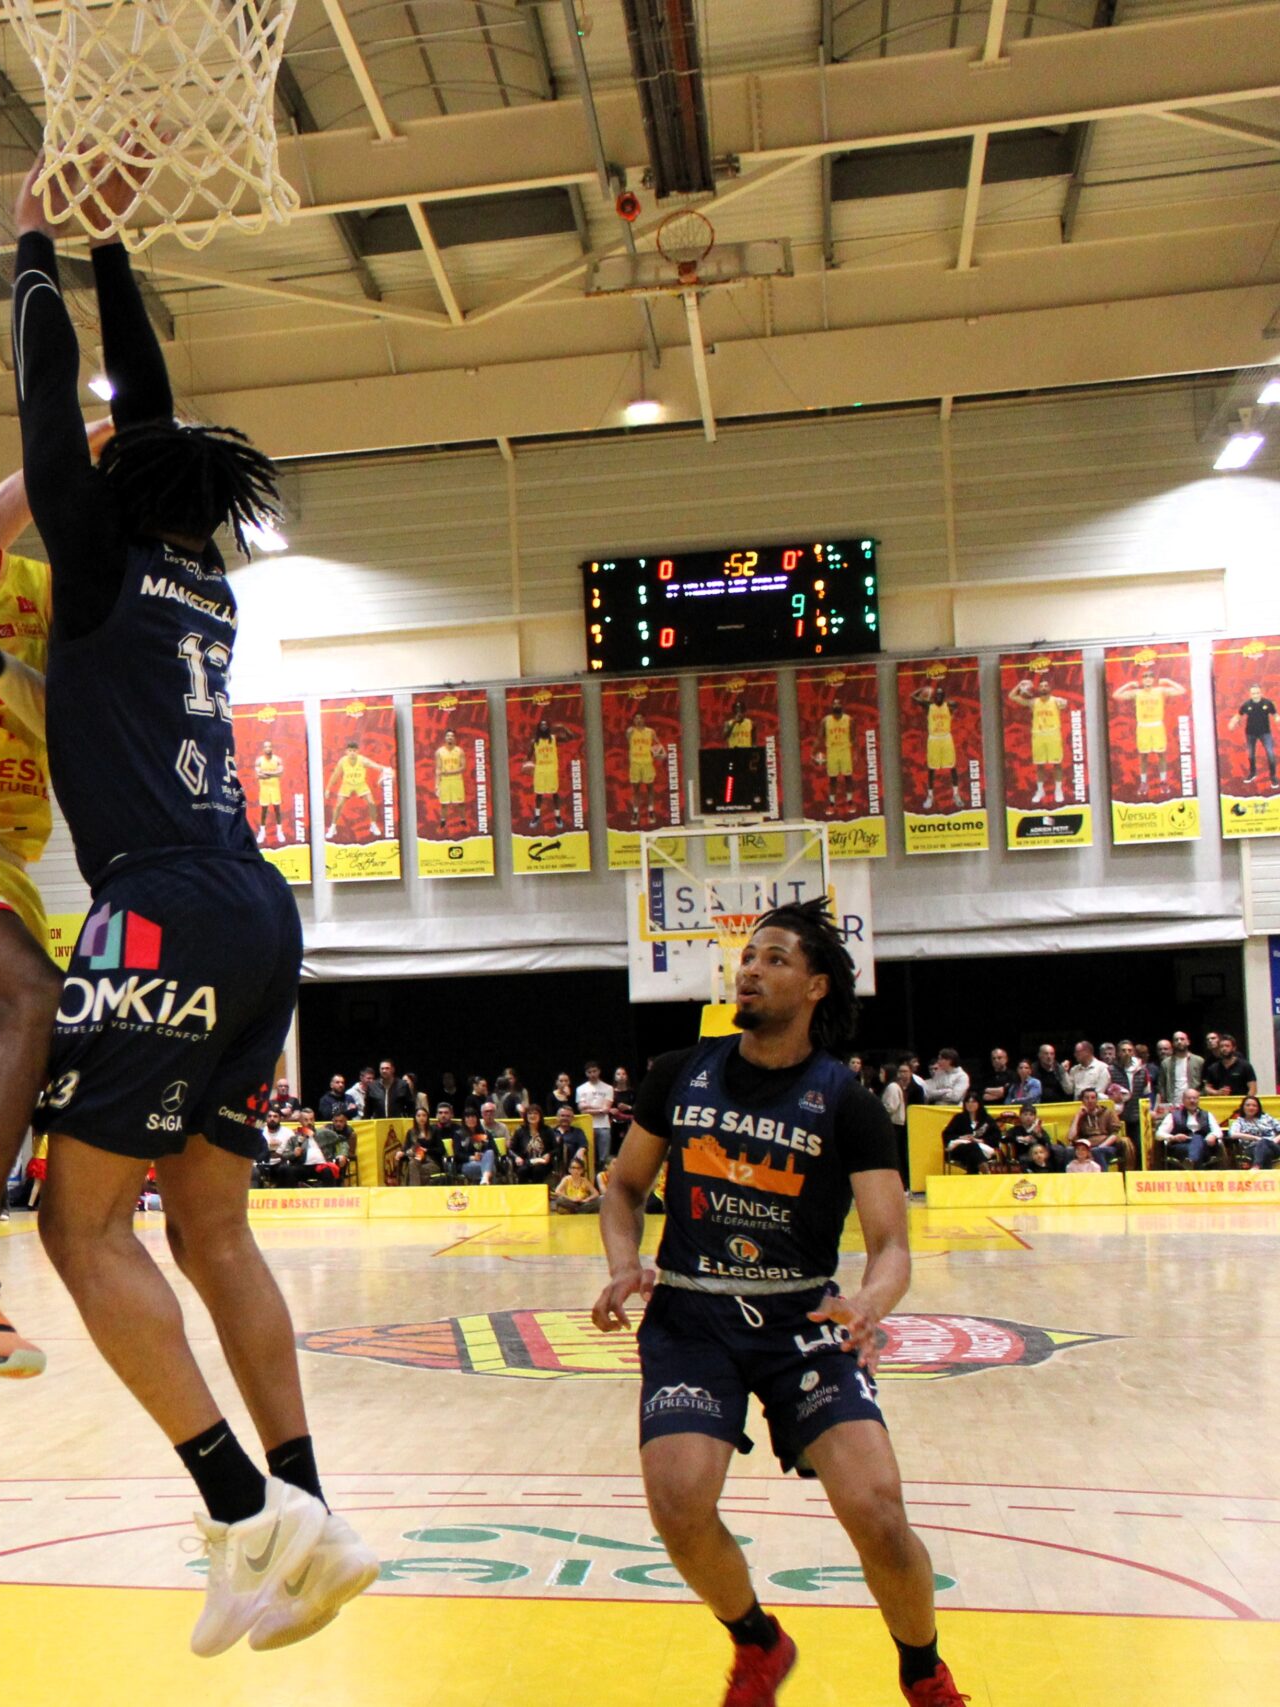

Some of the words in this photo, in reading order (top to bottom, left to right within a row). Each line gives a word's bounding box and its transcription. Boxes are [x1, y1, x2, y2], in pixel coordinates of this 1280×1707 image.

[791, 593, 805, 618] 9
[660, 628, 674, 648] 0
[475, 738, 486, 783] BOUCAUD
[477, 784, 488, 834] JONATHAN
[868, 783, 879, 814] DAVID
[573, 792, 584, 829] JORDAN
[1118, 808, 1158, 821] Versus
[909, 819, 984, 834] vanatome
[673, 1104, 717, 1128] LES
[720, 1110, 823, 1158] SABLES
[727, 1160, 754, 1182] 12
[1136, 1181, 1173, 1192] SAINT
[1176, 1181, 1224, 1193] VALLIER
[1228, 1180, 1276, 1192] BASKET
[281, 1198, 320, 1209] BASKET
[711, 1191, 791, 1224] VENDÉE
[711, 1215, 722, 1225] LE
[698, 1255, 803, 1280] E.Leclerc
[643, 1402, 657, 1414] AT
[659, 1398, 721, 1414] PRESTIGES
